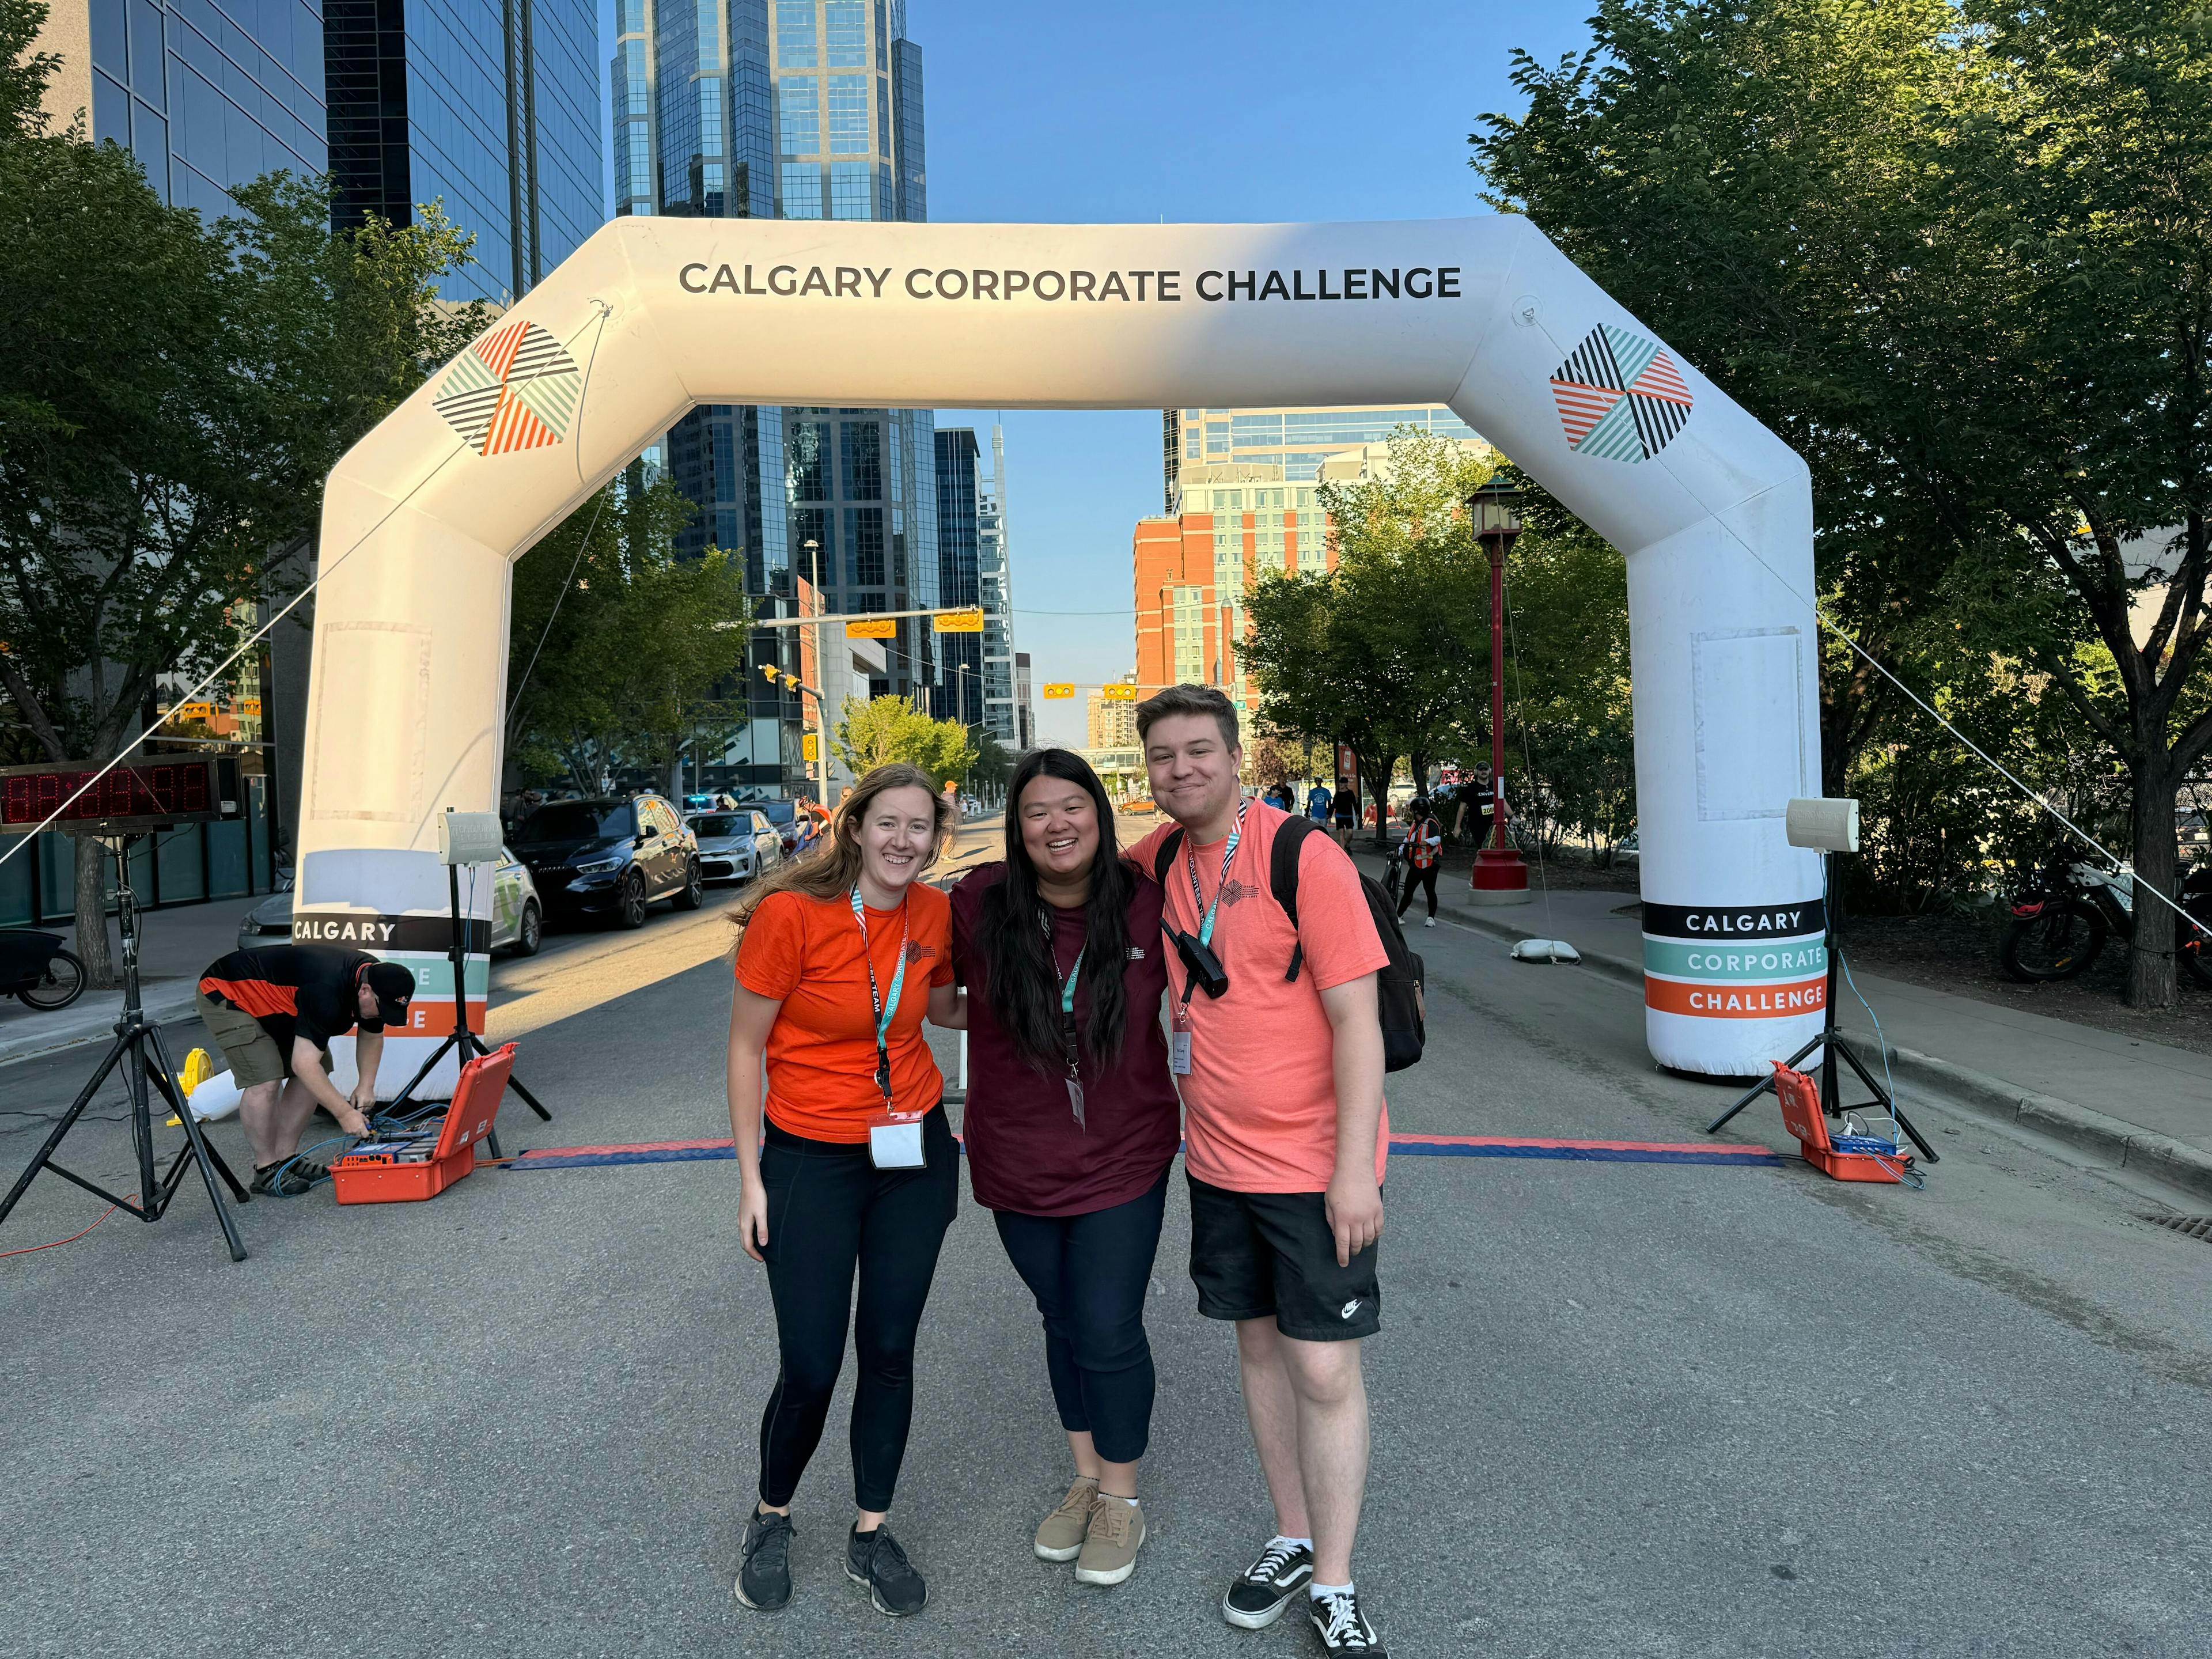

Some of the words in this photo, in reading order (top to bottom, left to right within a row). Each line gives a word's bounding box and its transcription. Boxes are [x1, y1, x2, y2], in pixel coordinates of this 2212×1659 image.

[679, 263, 892, 298] CALGARY
[905, 268, 1181, 301] CORPORATE
[1195, 267, 1461, 302] CHALLENGE
[1188, 855, 1202, 906] VOLUNTEER
[294, 921, 396, 941] CALGARY
[1686, 911, 1801, 931] CALGARY
[1688, 946, 1821, 971] CORPORATE
[886, 982, 900, 1016] CALGARY
[895, 937, 907, 980] CORPORATE
[871, 984, 880, 1012] TEAM
[1689, 986, 1822, 1010] CHALLENGE
